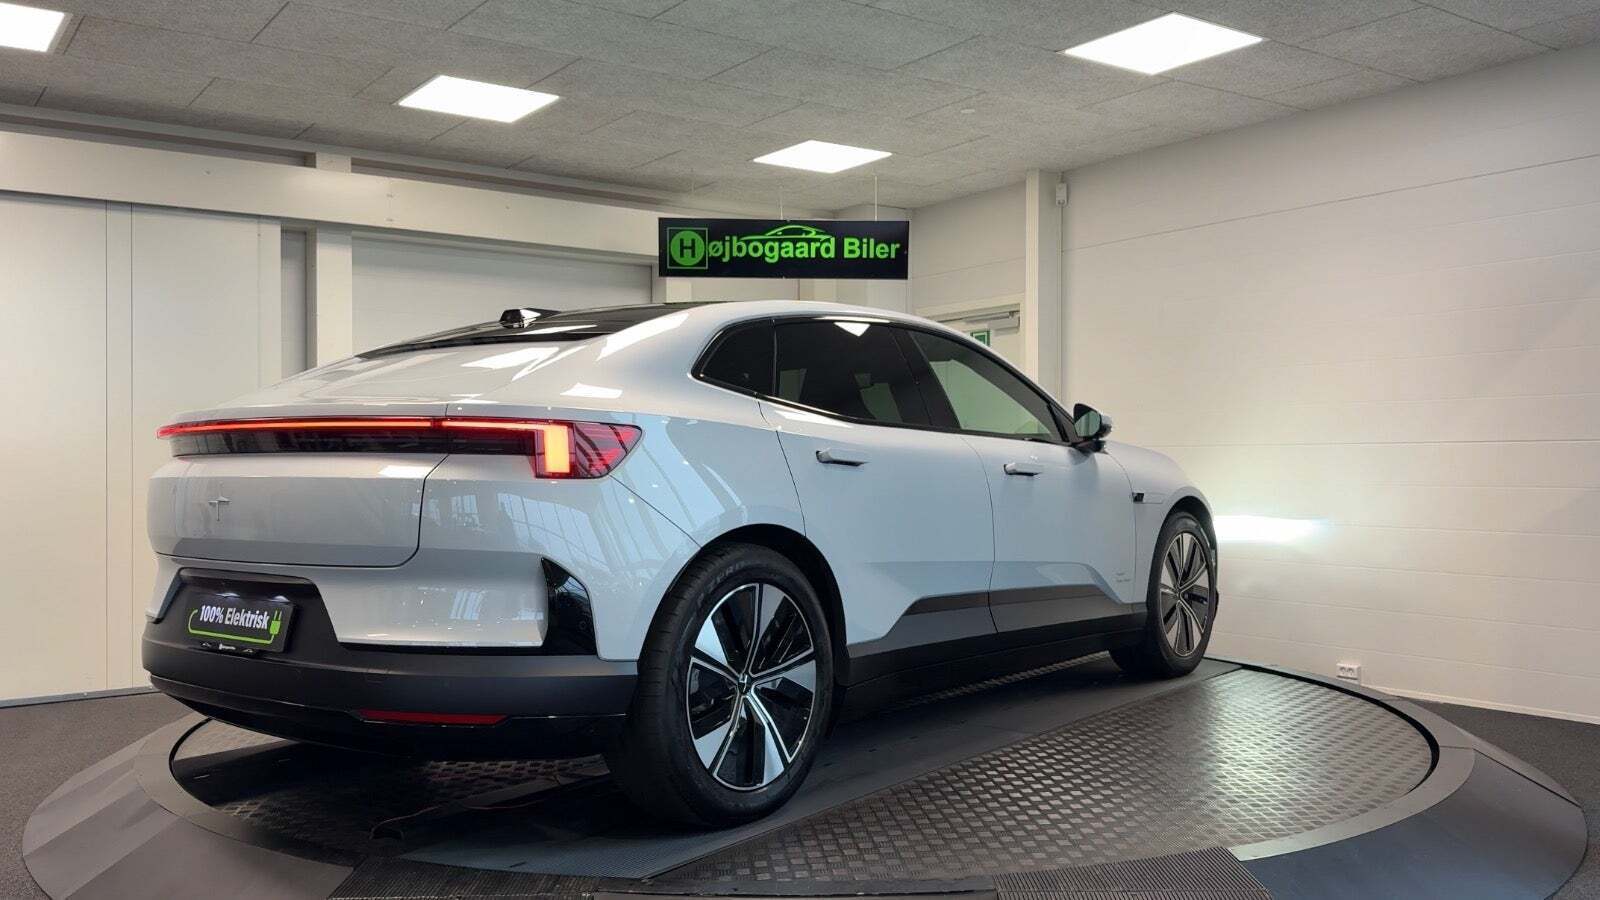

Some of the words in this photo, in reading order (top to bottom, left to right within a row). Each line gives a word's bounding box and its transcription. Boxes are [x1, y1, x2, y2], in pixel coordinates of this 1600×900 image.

[674, 235, 836, 263] Højbogaard
[843, 237, 900, 259] Biler
[200, 605, 225, 623] 100%
[224, 607, 270, 630] Elektrisk
